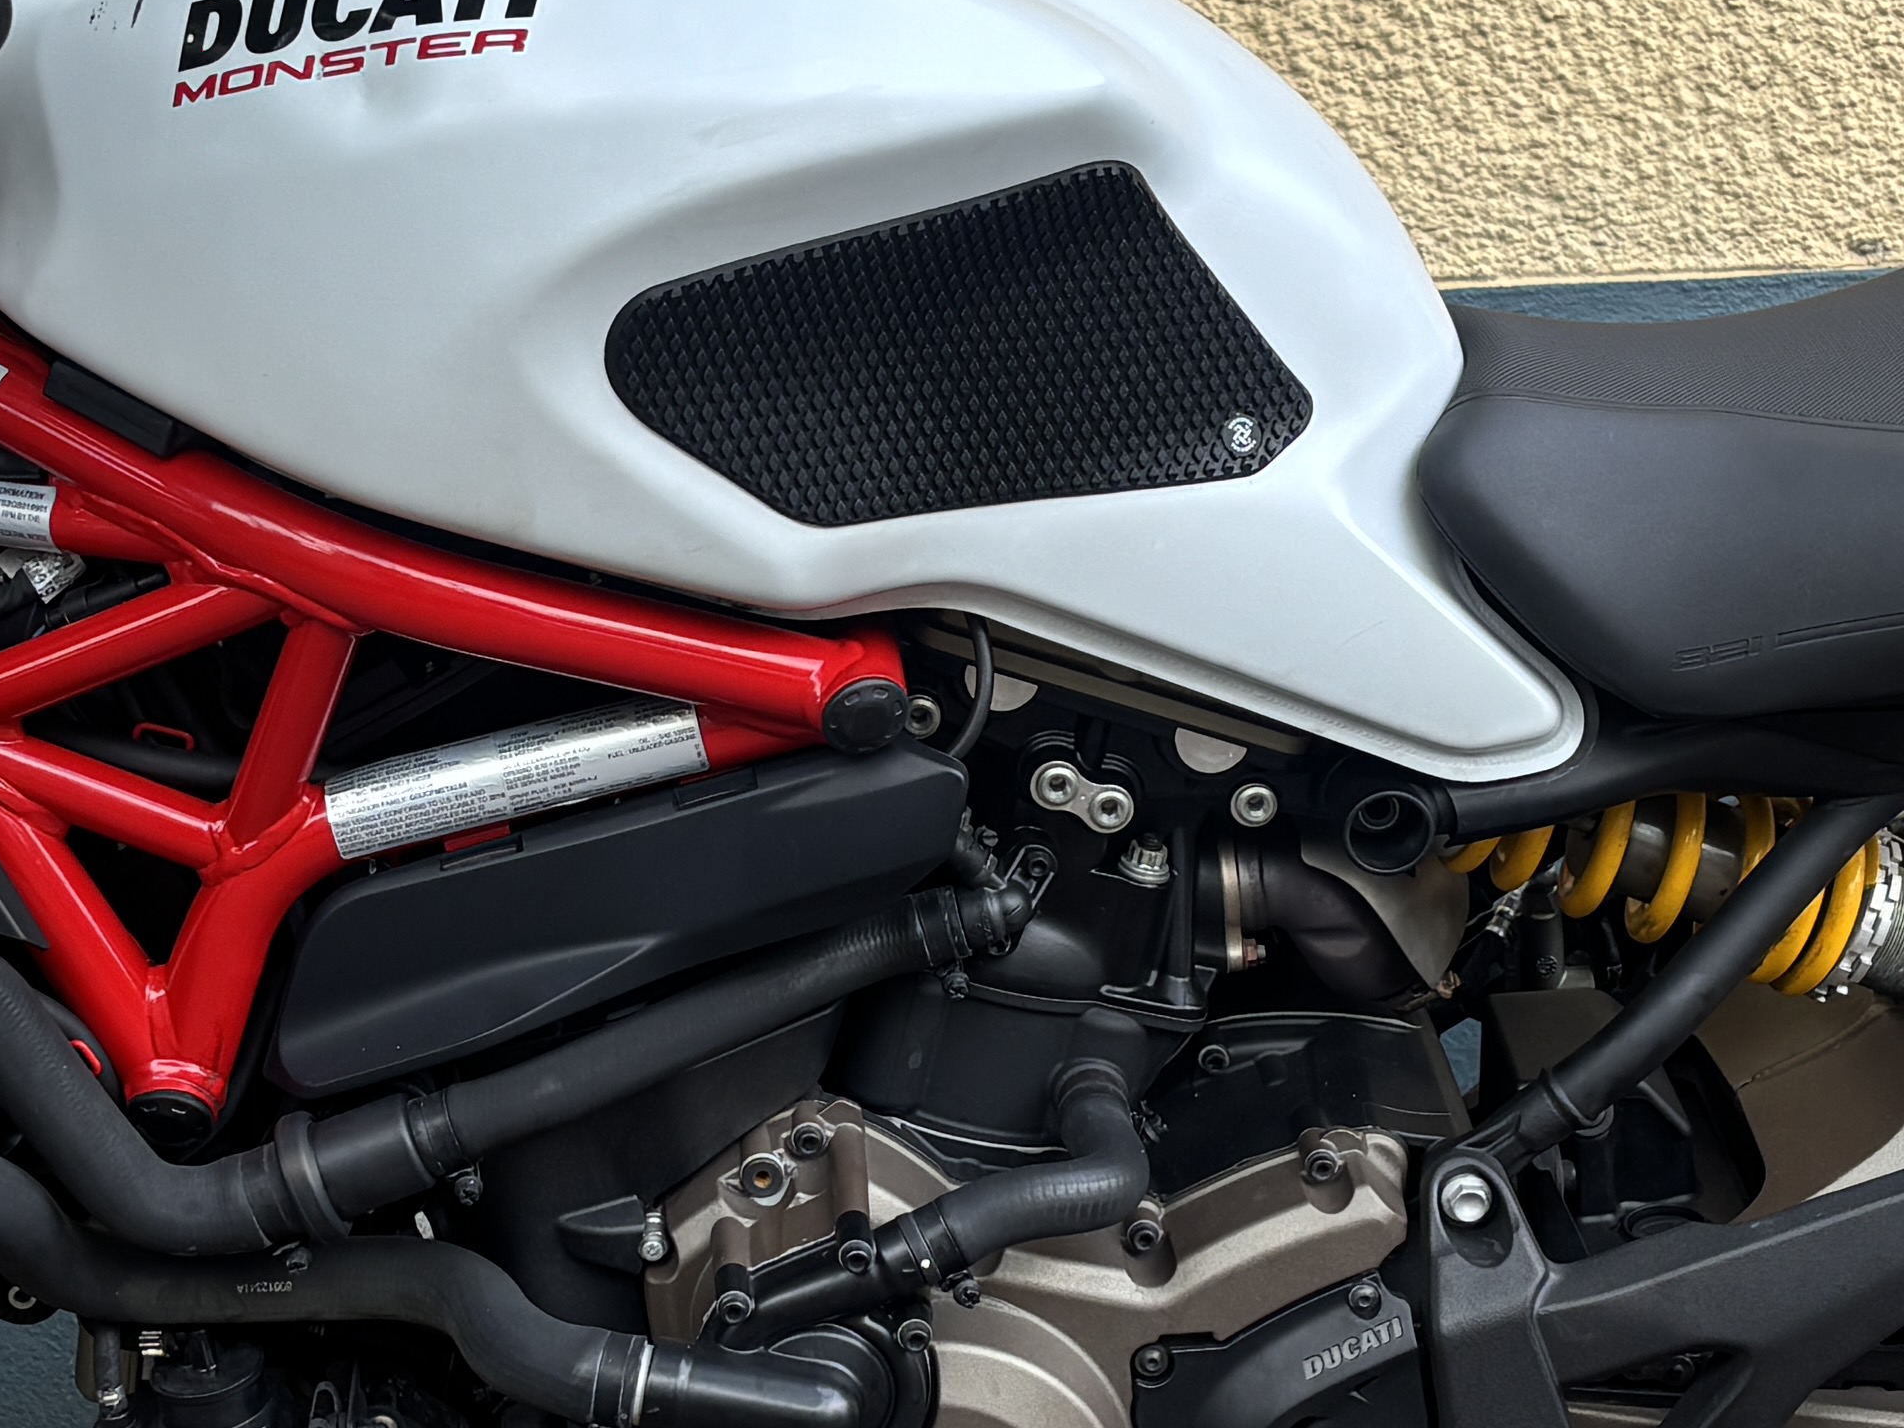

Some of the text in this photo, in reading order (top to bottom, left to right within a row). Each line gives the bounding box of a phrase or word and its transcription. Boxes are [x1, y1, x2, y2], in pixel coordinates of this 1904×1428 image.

[172, 28, 529, 108] MONSTER
[1672, 635, 1763, 672] 821
[1302, 1316, 1404, 1381] DUCATI
